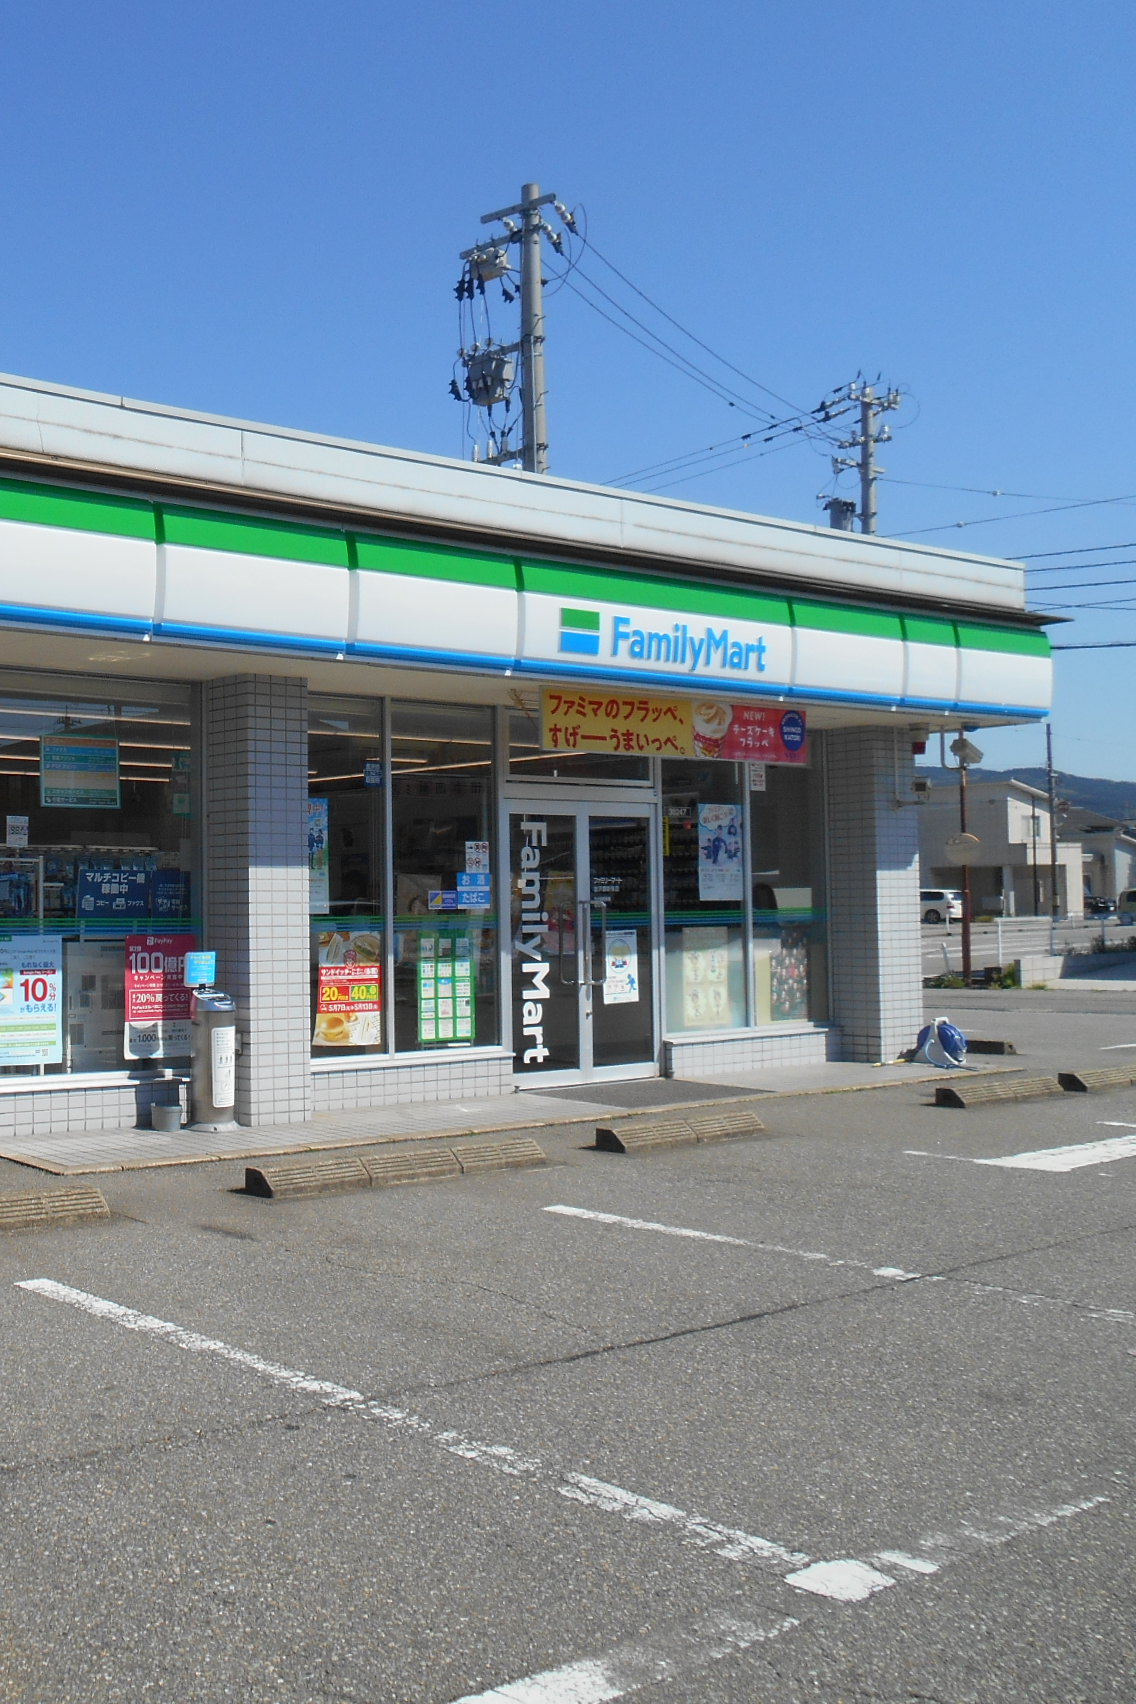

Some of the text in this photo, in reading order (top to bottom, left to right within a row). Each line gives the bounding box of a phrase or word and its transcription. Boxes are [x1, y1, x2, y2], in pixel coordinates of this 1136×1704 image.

[612, 615, 767, 672] FamilyMart
[549, 695, 685, 725] ファミマのフラッペ、
[514, 820, 551, 1065] FamilyMart
[20, 977, 49, 1002] 10
[322, 986, 367, 1001] 20 40
